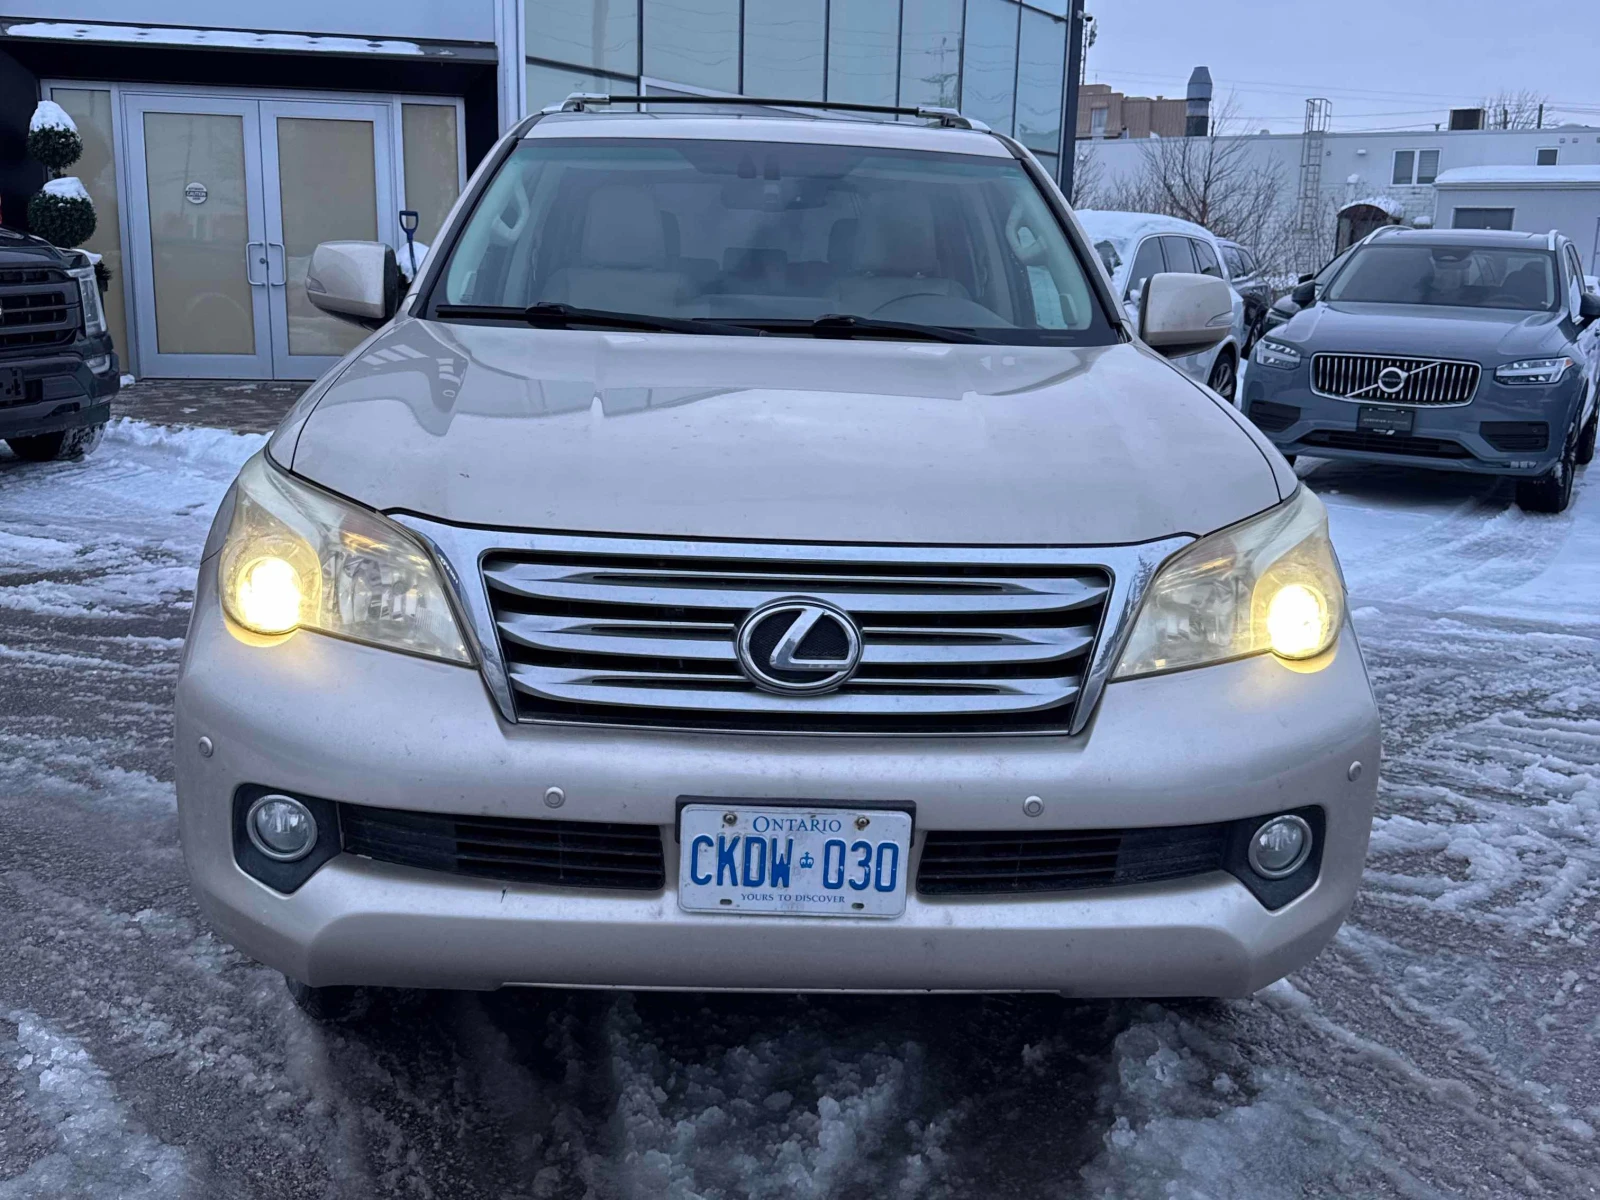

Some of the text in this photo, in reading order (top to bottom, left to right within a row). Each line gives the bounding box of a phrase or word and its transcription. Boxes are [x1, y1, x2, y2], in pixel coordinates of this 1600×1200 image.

[752, 816, 842, 834] ONTARIO
[690, 834, 899, 893] CKDW 030
[741, 893, 845, 903] YOURS TO DISCOVER
